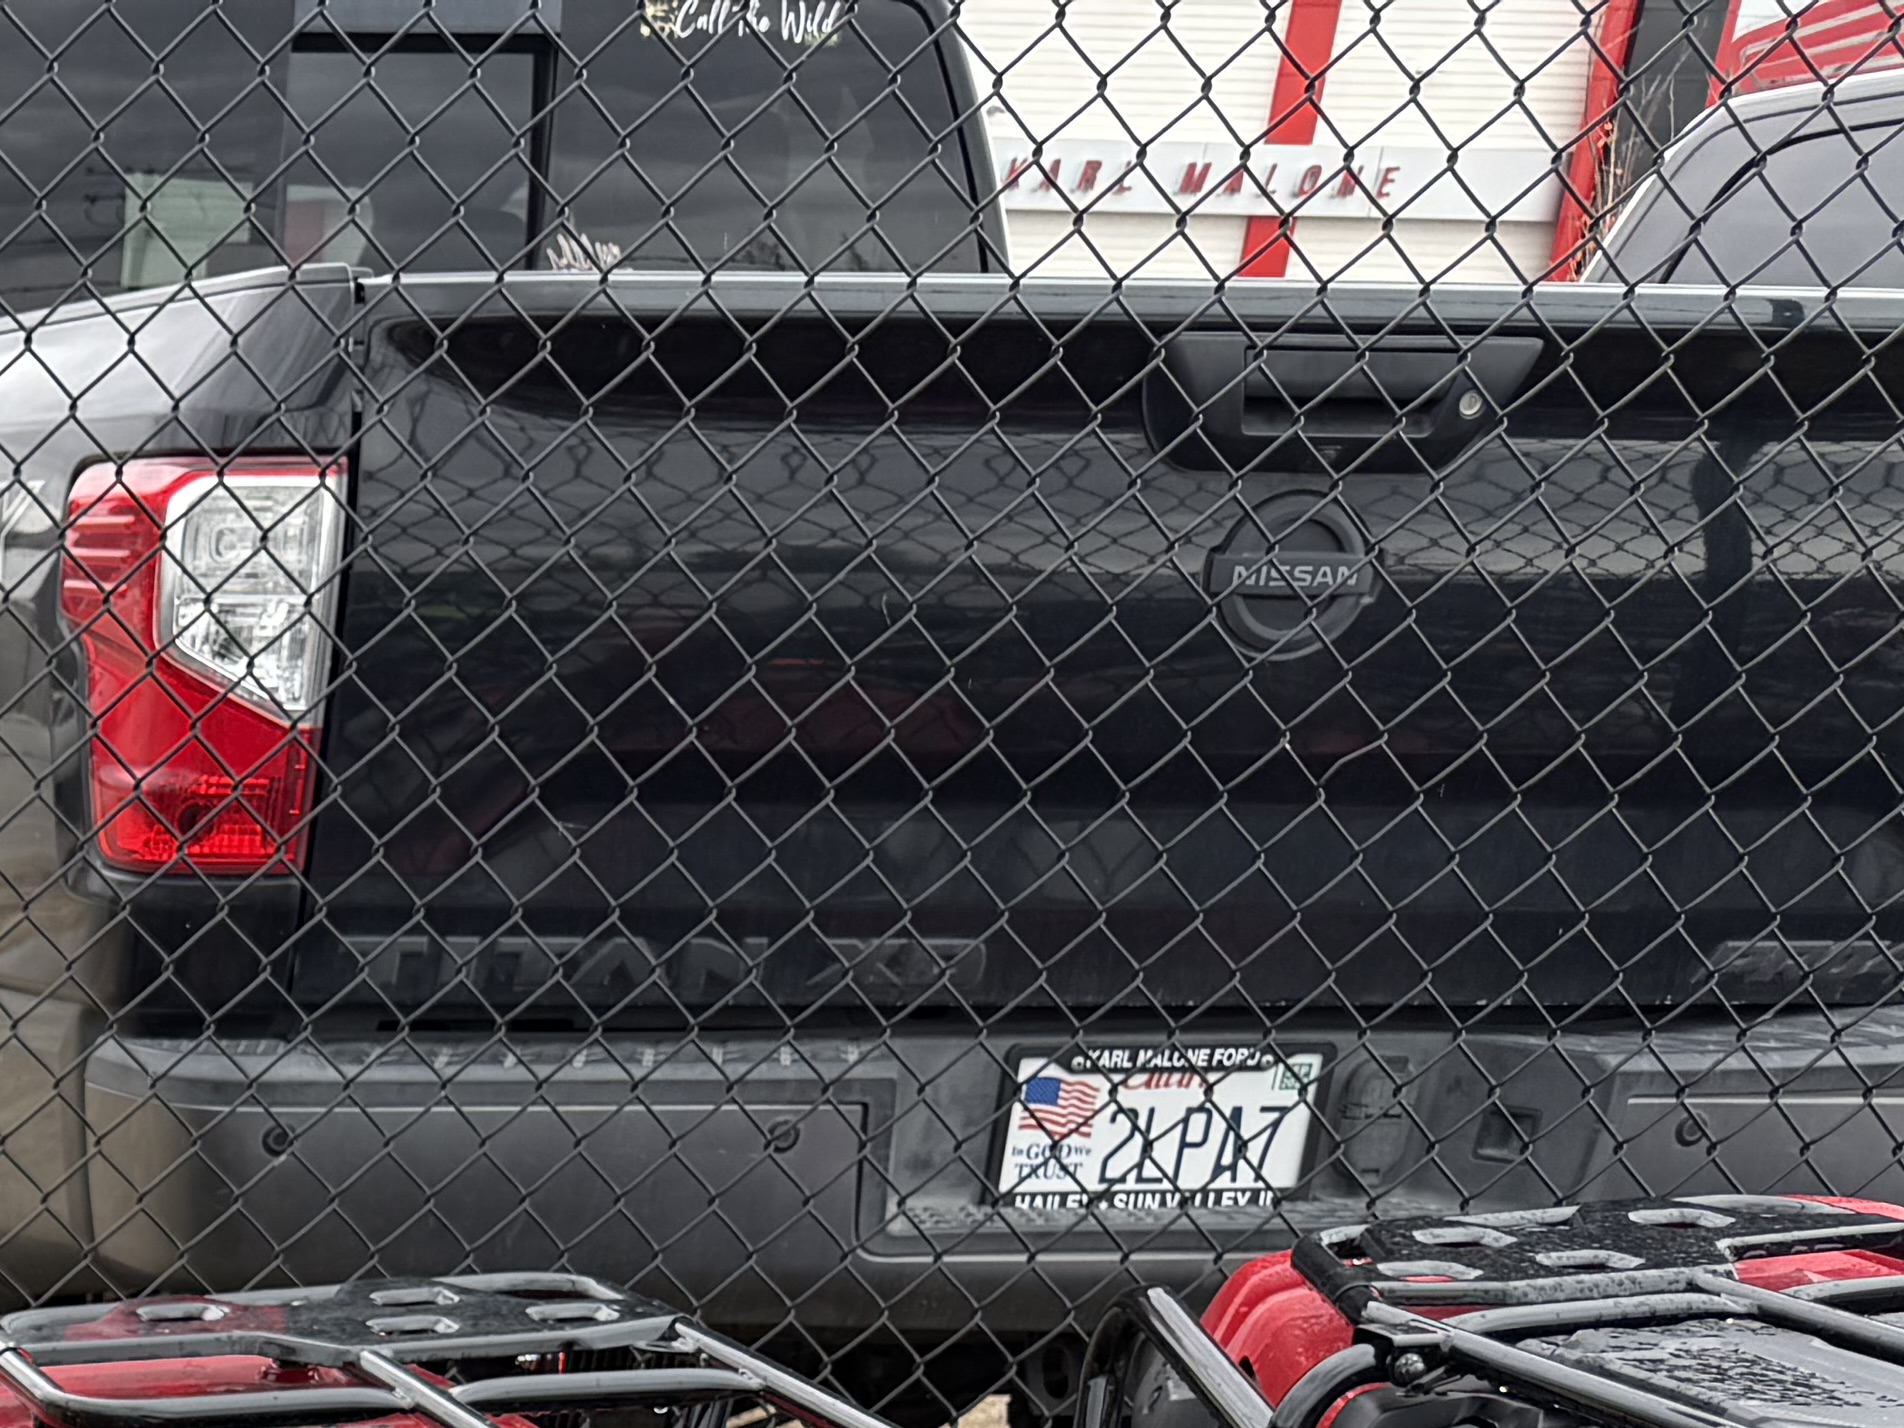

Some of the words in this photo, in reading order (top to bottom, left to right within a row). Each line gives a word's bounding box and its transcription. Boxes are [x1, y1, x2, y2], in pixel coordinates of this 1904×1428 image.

[1005, 157, 1133, 197] KARL
[1173, 159, 1402, 199] MALONE
[1232, 564, 1359, 587] NISSAN
[1085, 1048, 1132, 1069] KARL
[1135, 1048, 1210, 1068] MALONE
